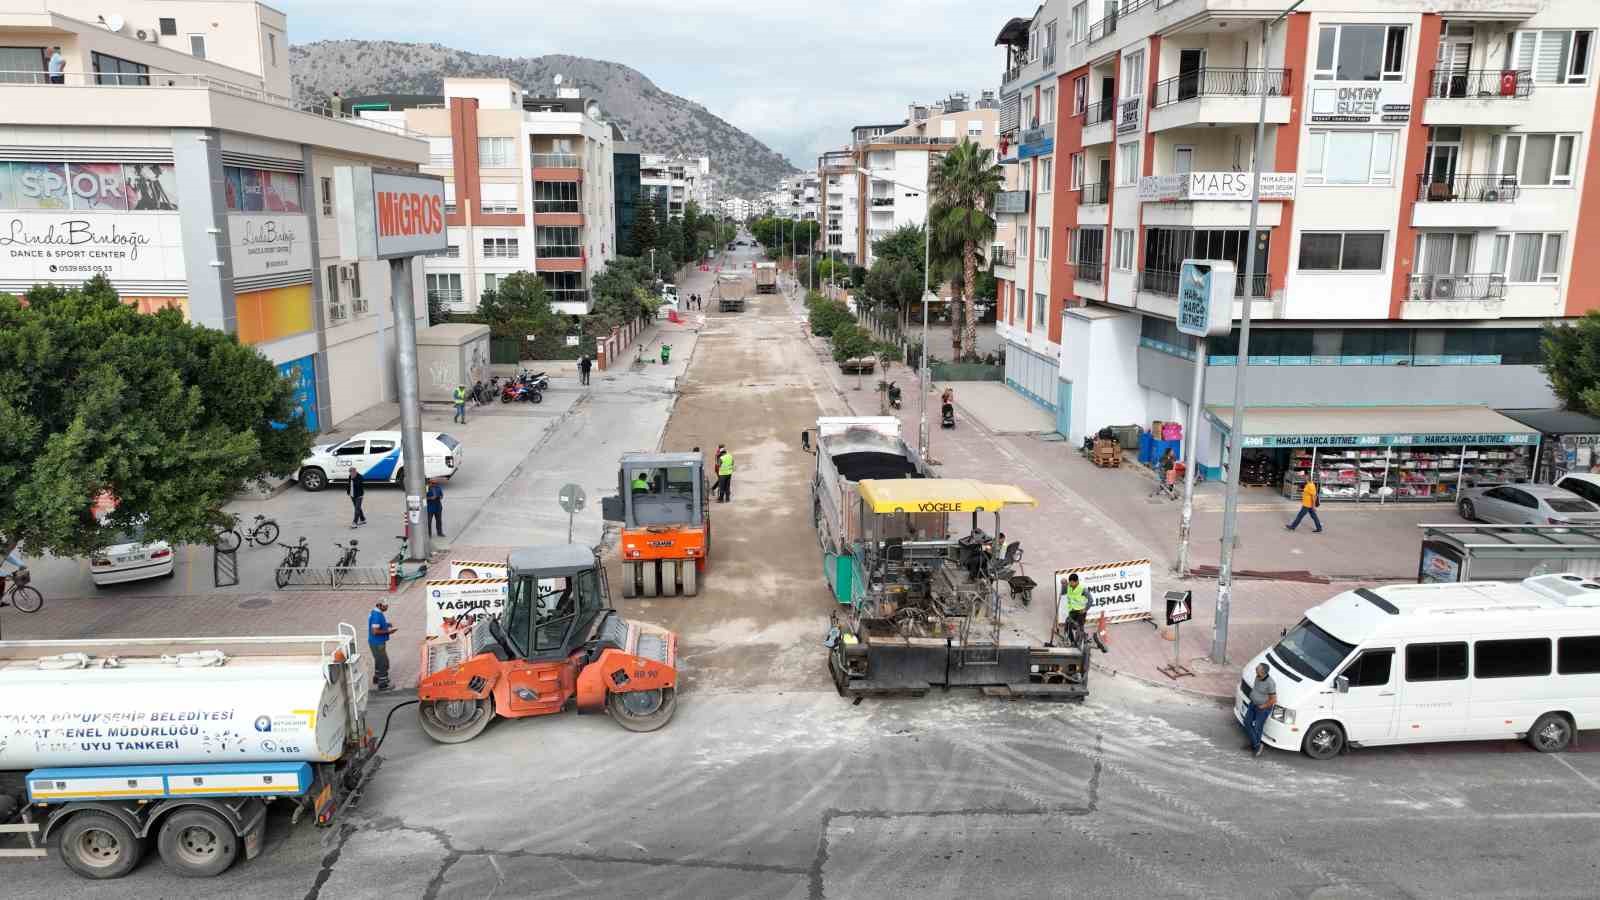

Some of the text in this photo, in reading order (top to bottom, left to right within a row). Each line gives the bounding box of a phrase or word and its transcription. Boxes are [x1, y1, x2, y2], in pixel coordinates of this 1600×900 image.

[21, 172, 122, 200] SPOR
[1192, 174, 1247, 191] MARS
[89, 250, 126, 258] CENTER
[1425, 435, 1449, 443] HARCA
[1450, 435, 1476, 443] HARCA
[918, 502, 961, 512] VÖGELE
[1088, 579, 1143, 594] MUR SUYU
[437, 599, 491, 610] YAĞMUR
[1090, 593, 1135, 607] LIŞMASI
[150, 708, 234, 721] BELEDİYESİ
[108, 724, 199, 737] MÜDÜRLÜĞÜ
